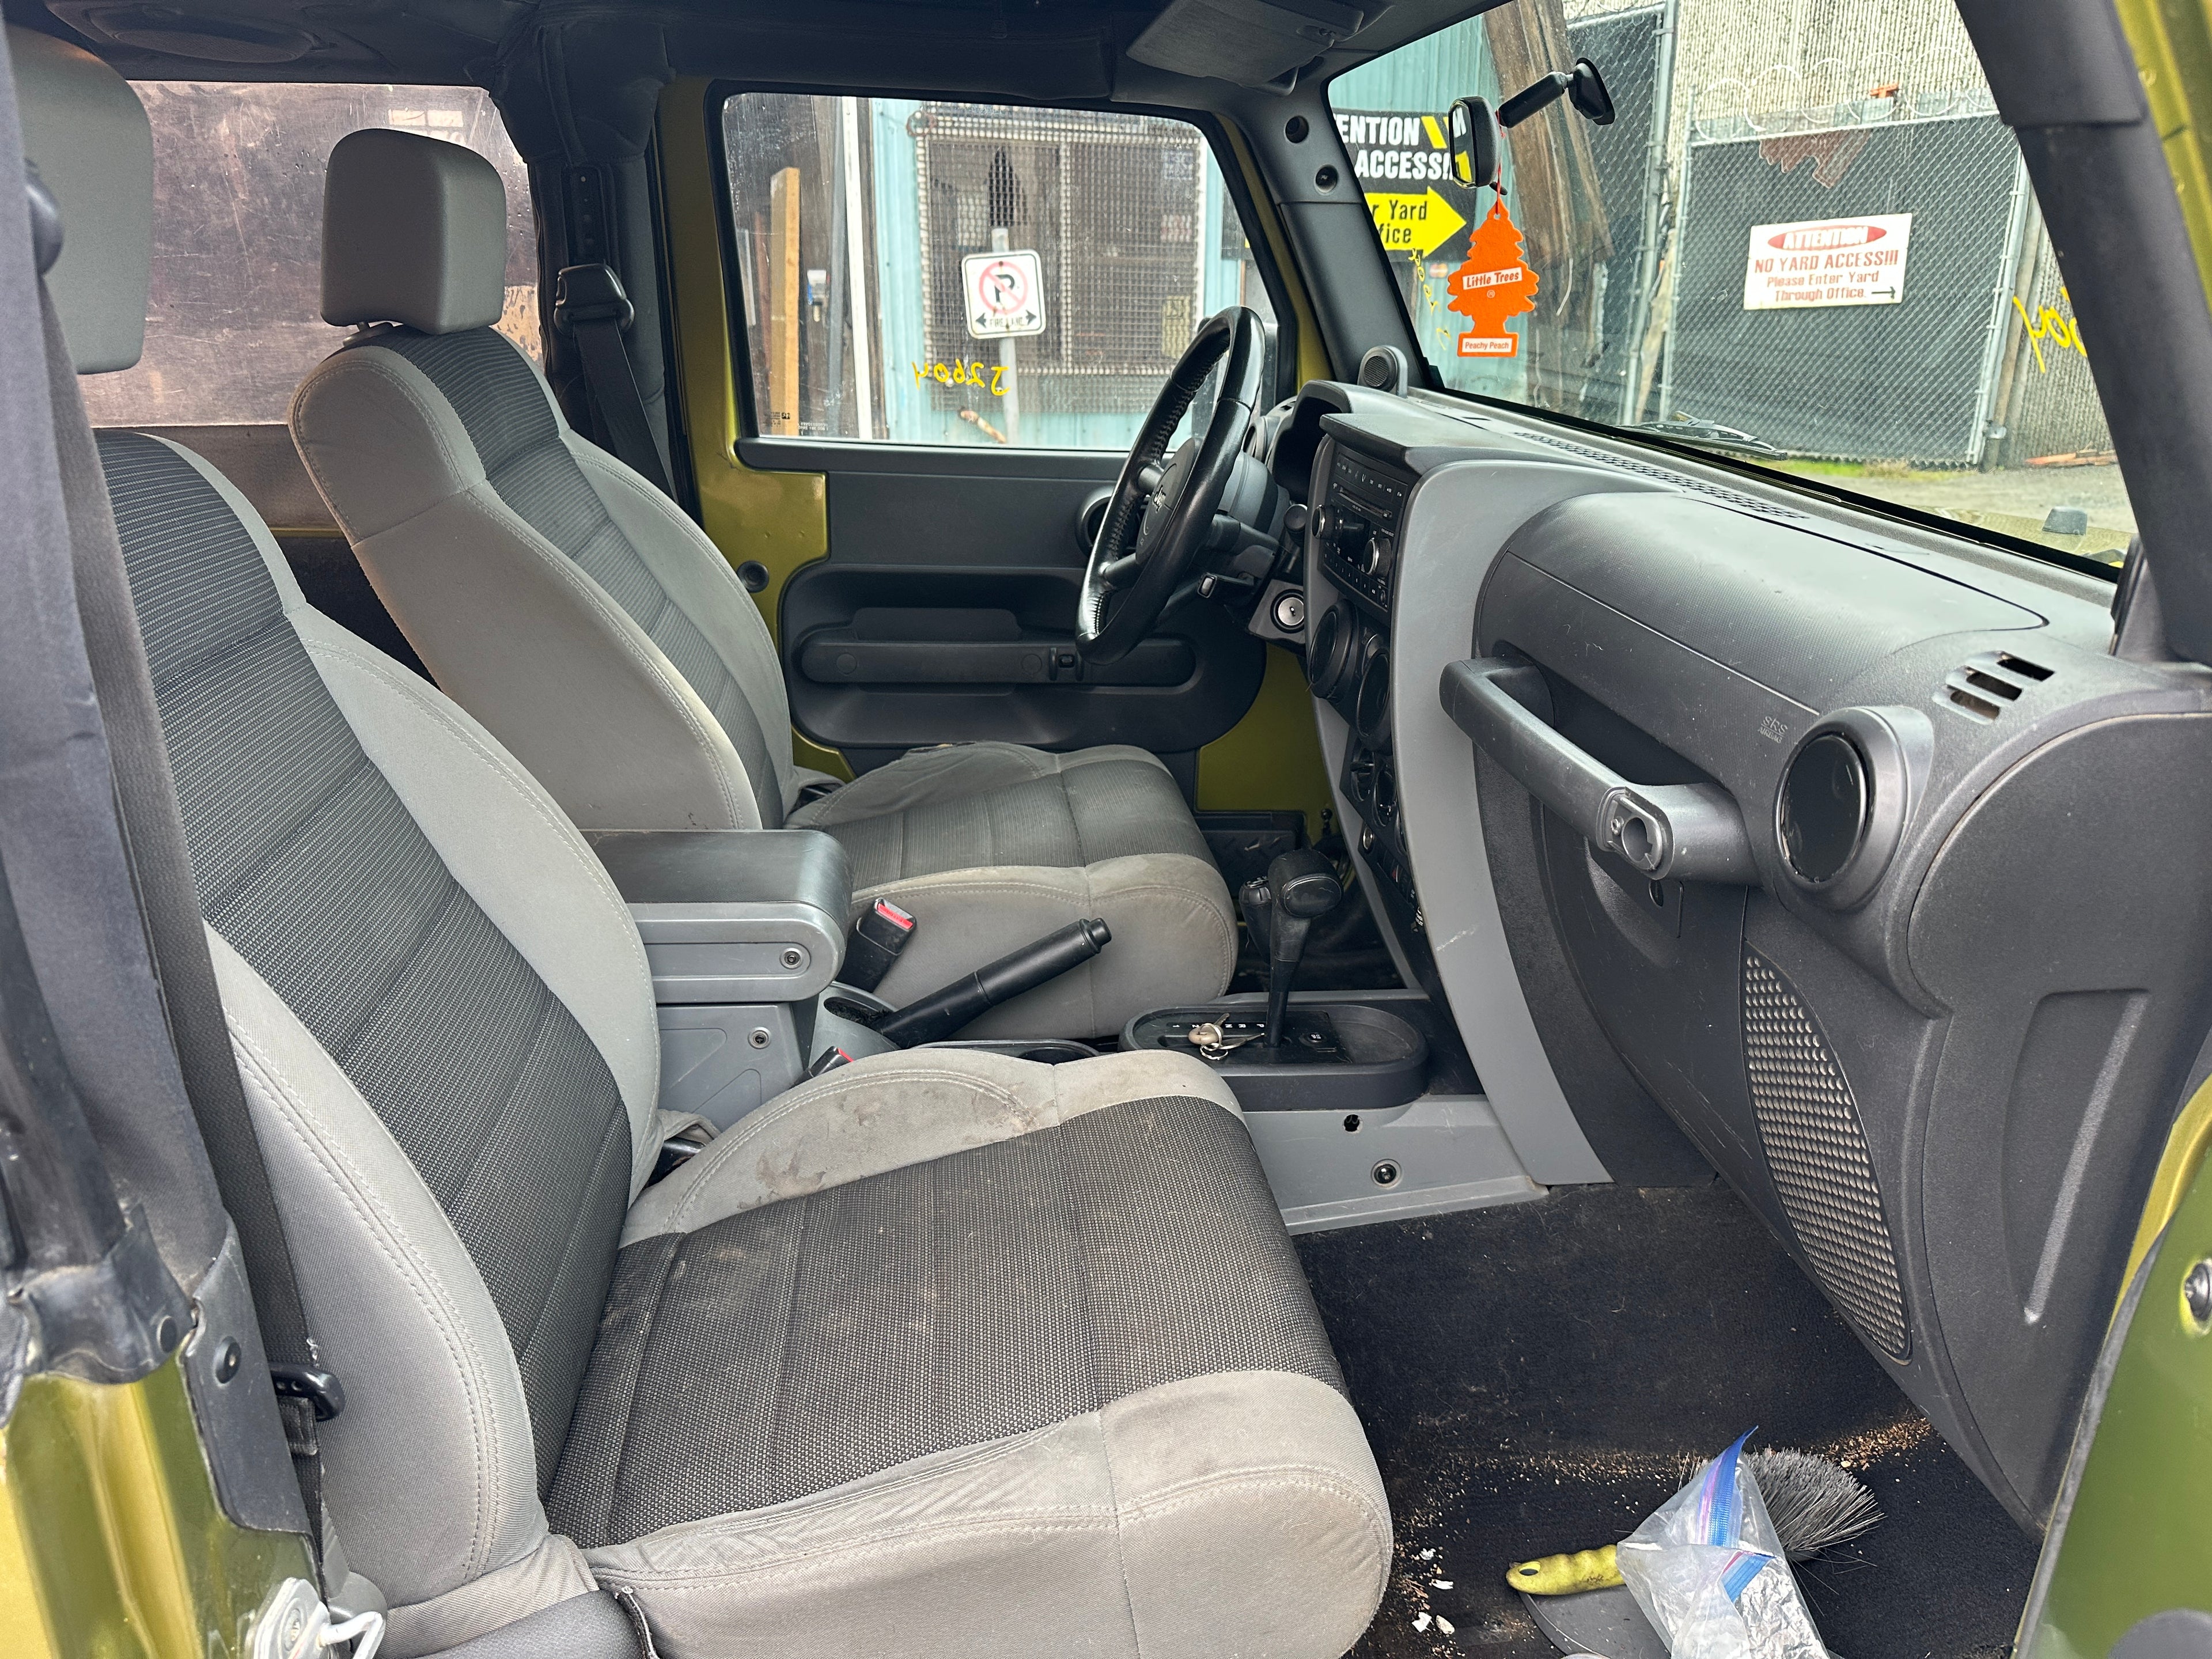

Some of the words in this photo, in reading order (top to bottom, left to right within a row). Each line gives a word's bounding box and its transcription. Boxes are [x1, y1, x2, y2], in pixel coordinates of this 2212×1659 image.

[1334, 113, 1421, 146] ENTION
[1389, 199, 1427, 220] Yard
[1783, 226, 1868, 249] ATTENTION
[1755, 258, 1774, 274] NO
[1780, 256, 1819, 271] YARD
[1824, 250, 1899, 269] ACCESS!!!
[1467, 274, 1491, 287] Little
[1494, 272, 1519, 283] Trees
[1767, 276, 1805, 288] Please
[1809, 274, 1843, 286] Enter
[1849, 271, 1879, 283] Yard
[1775, 289, 1823, 302] Through
[1465, 342, 1488, 350] Peachy
